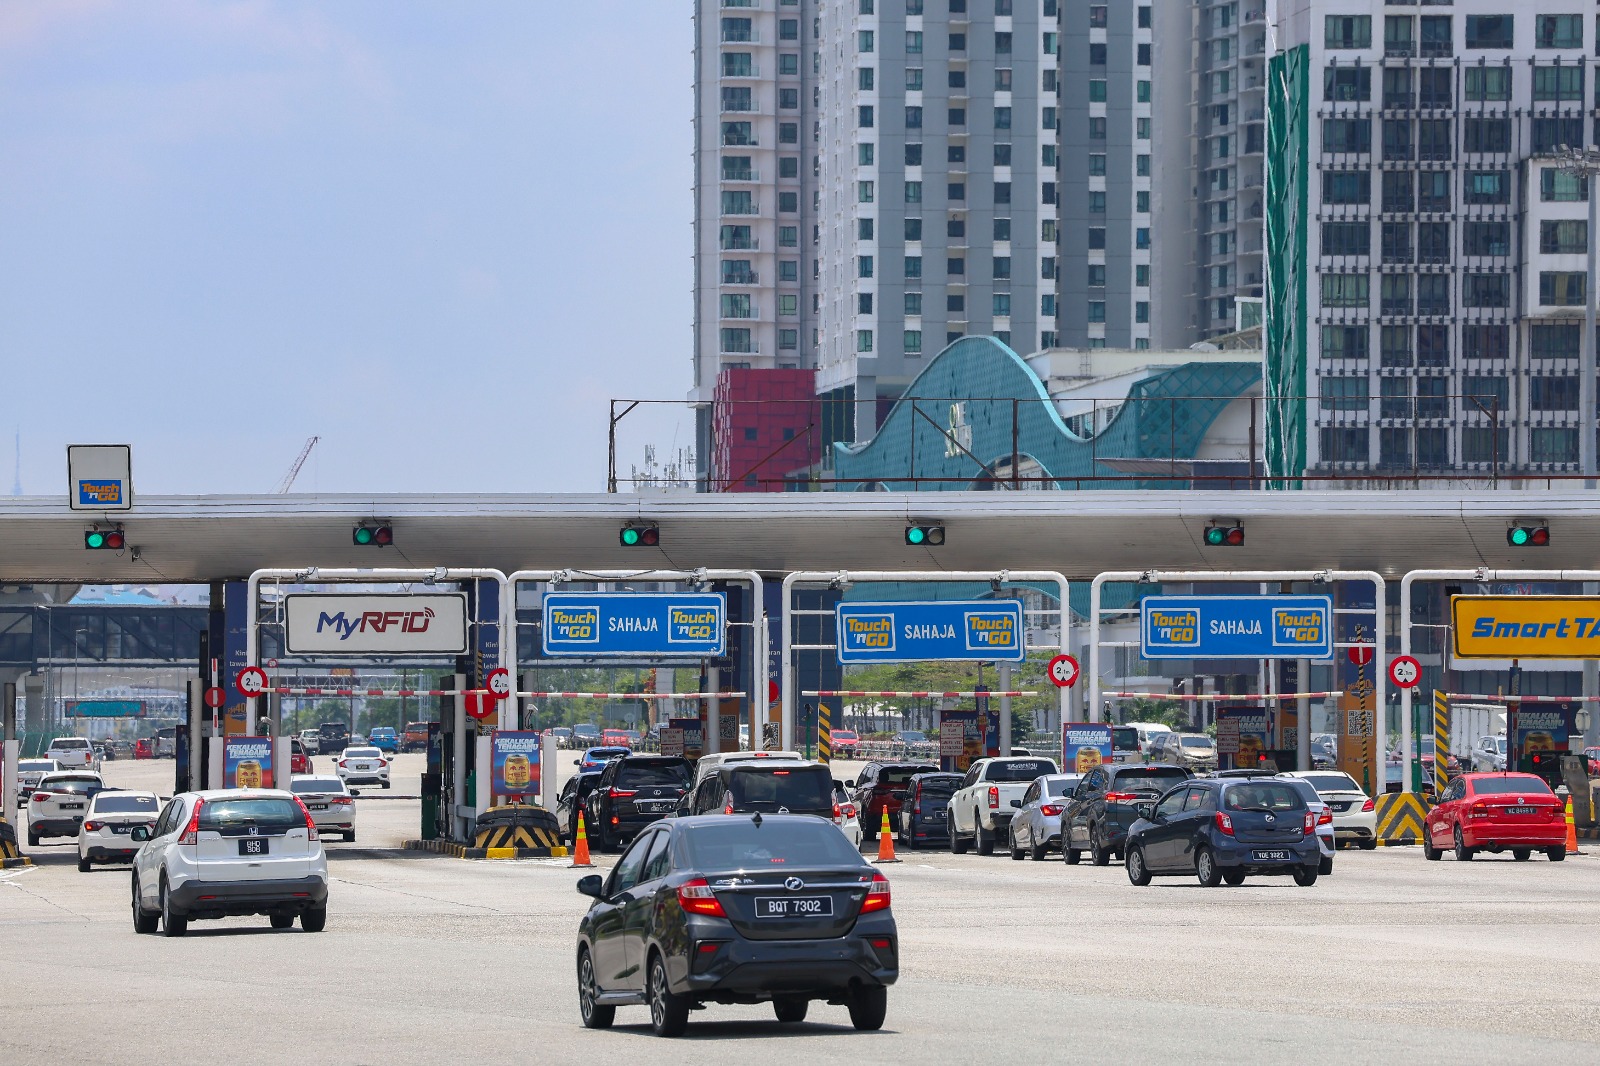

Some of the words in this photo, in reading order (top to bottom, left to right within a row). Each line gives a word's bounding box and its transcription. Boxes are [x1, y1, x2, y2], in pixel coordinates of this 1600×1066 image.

[82, 483, 119, 493] Touch
[553, 611, 596, 624] Touch
[608, 617, 659, 632] SAHAJA
[673, 611, 715, 624] Touch
[969, 616, 1013, 630] Touch
[1152, 612, 1195, 626] Touch
[1277, 612, 1321, 626] Touch
[847, 618, 891, 632] Touch
[904, 624, 956, 639] SAHAJA
[1209, 619, 1263, 635] SAHAJA
[768, 901, 790, 913] BQT
[793, 900, 822, 913] 7302
